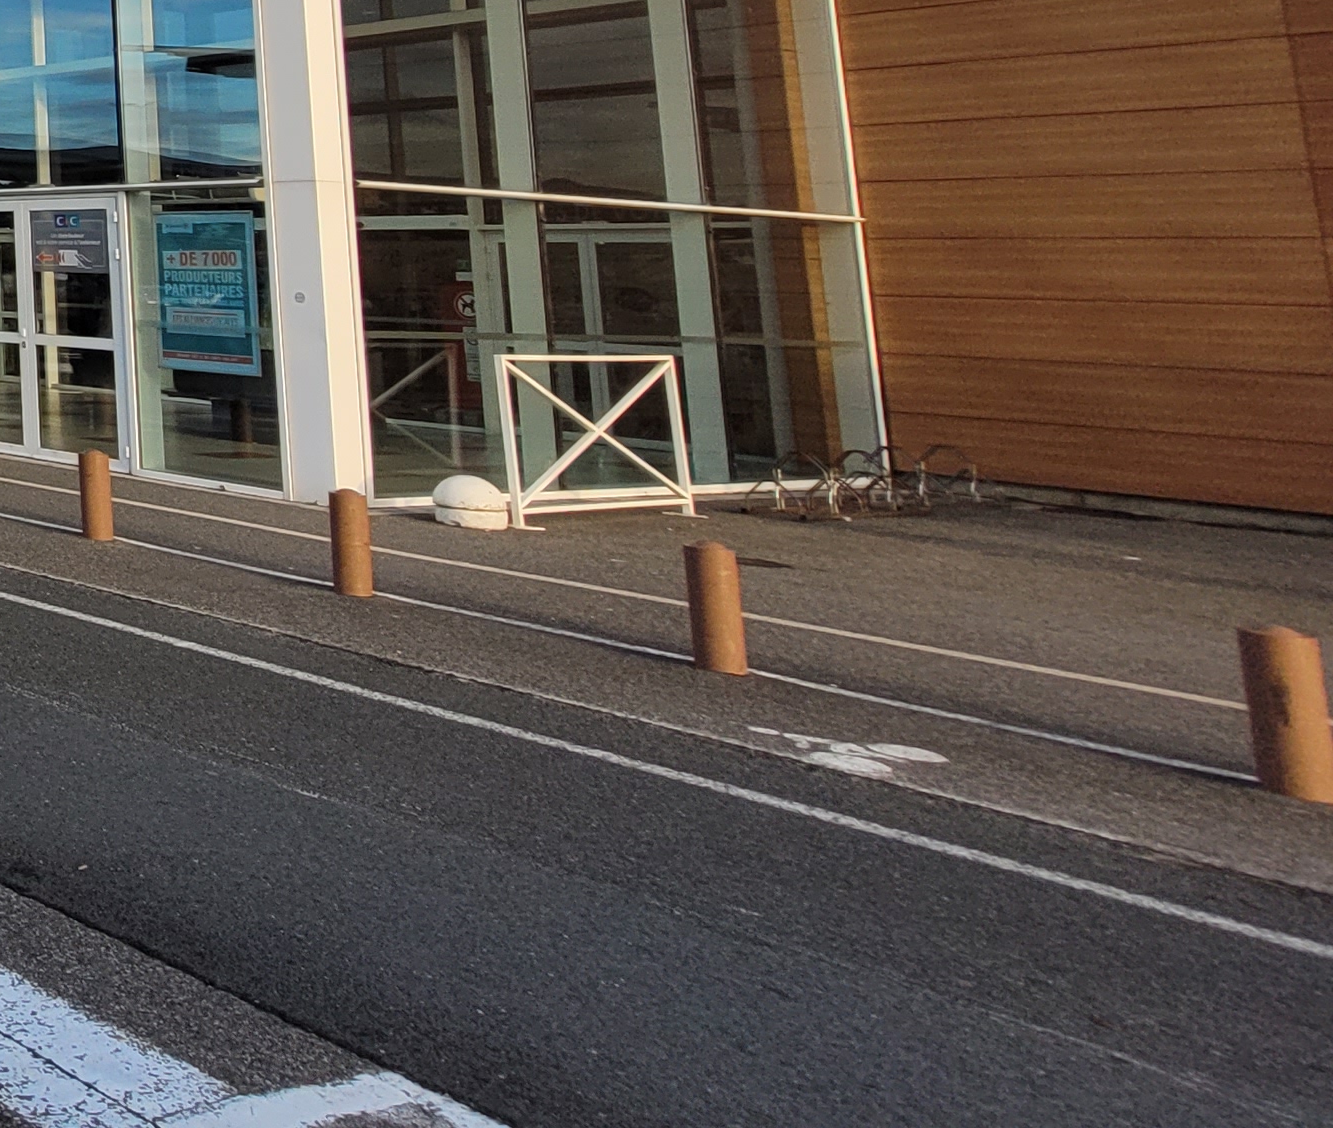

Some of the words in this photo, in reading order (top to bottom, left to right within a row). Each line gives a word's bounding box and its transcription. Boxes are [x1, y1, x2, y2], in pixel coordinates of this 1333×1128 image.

[179, 252, 197, 266] DE
[163, 270, 243, 284] PRODUCTEURS
[164, 283, 244, 299] PARTENAIRES
